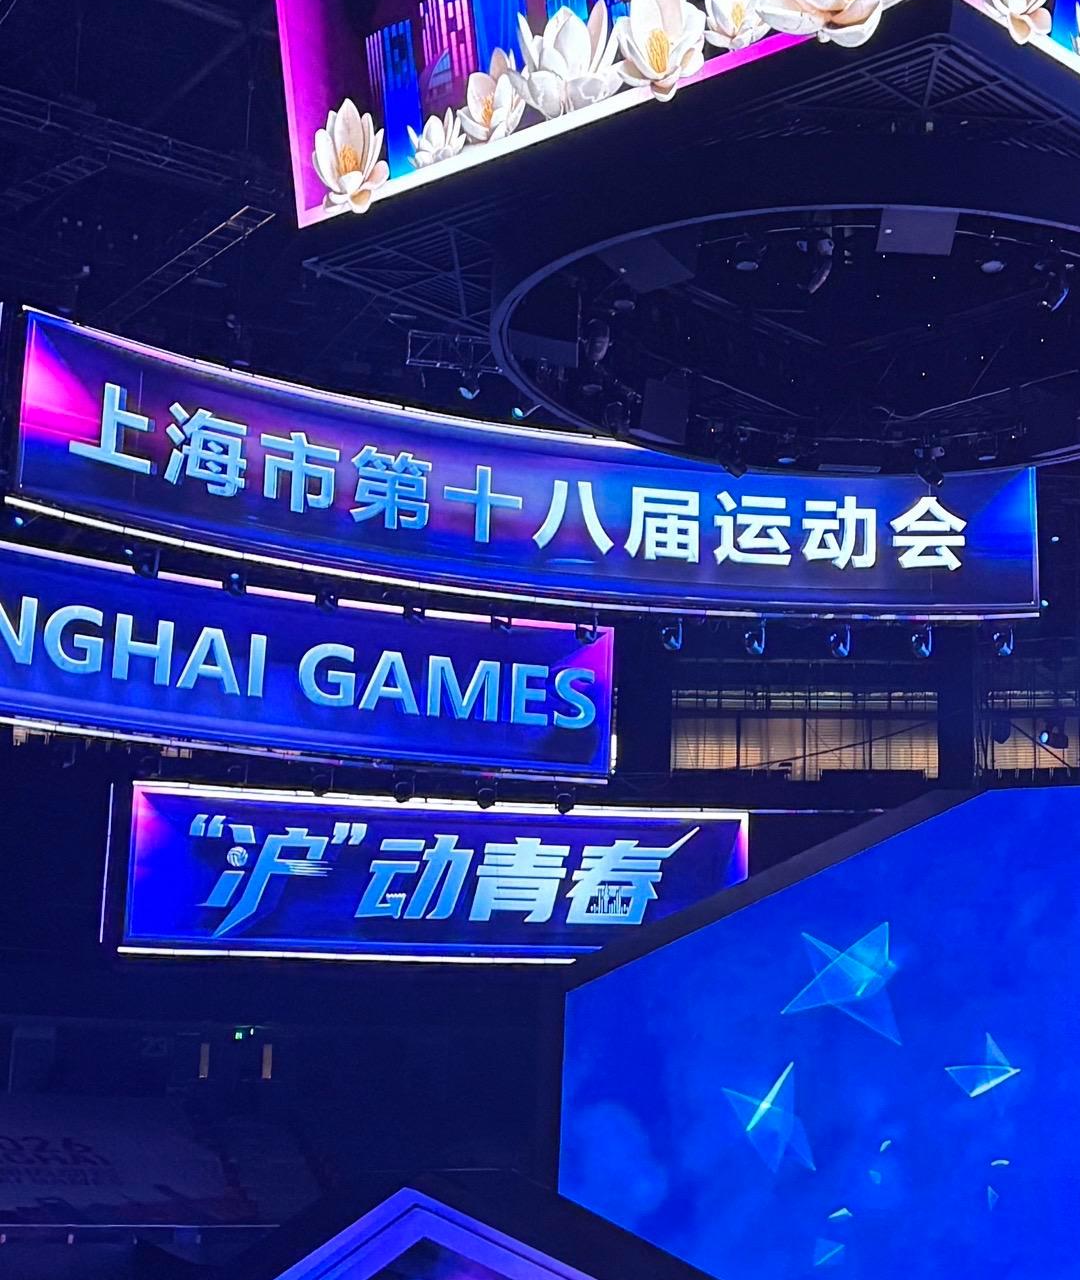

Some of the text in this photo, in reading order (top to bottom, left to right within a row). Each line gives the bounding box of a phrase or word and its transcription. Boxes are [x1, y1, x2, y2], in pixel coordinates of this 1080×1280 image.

[69, 382, 967, 570] 上海市第十八届运动会
[299, 643, 597, 729] GAMES
